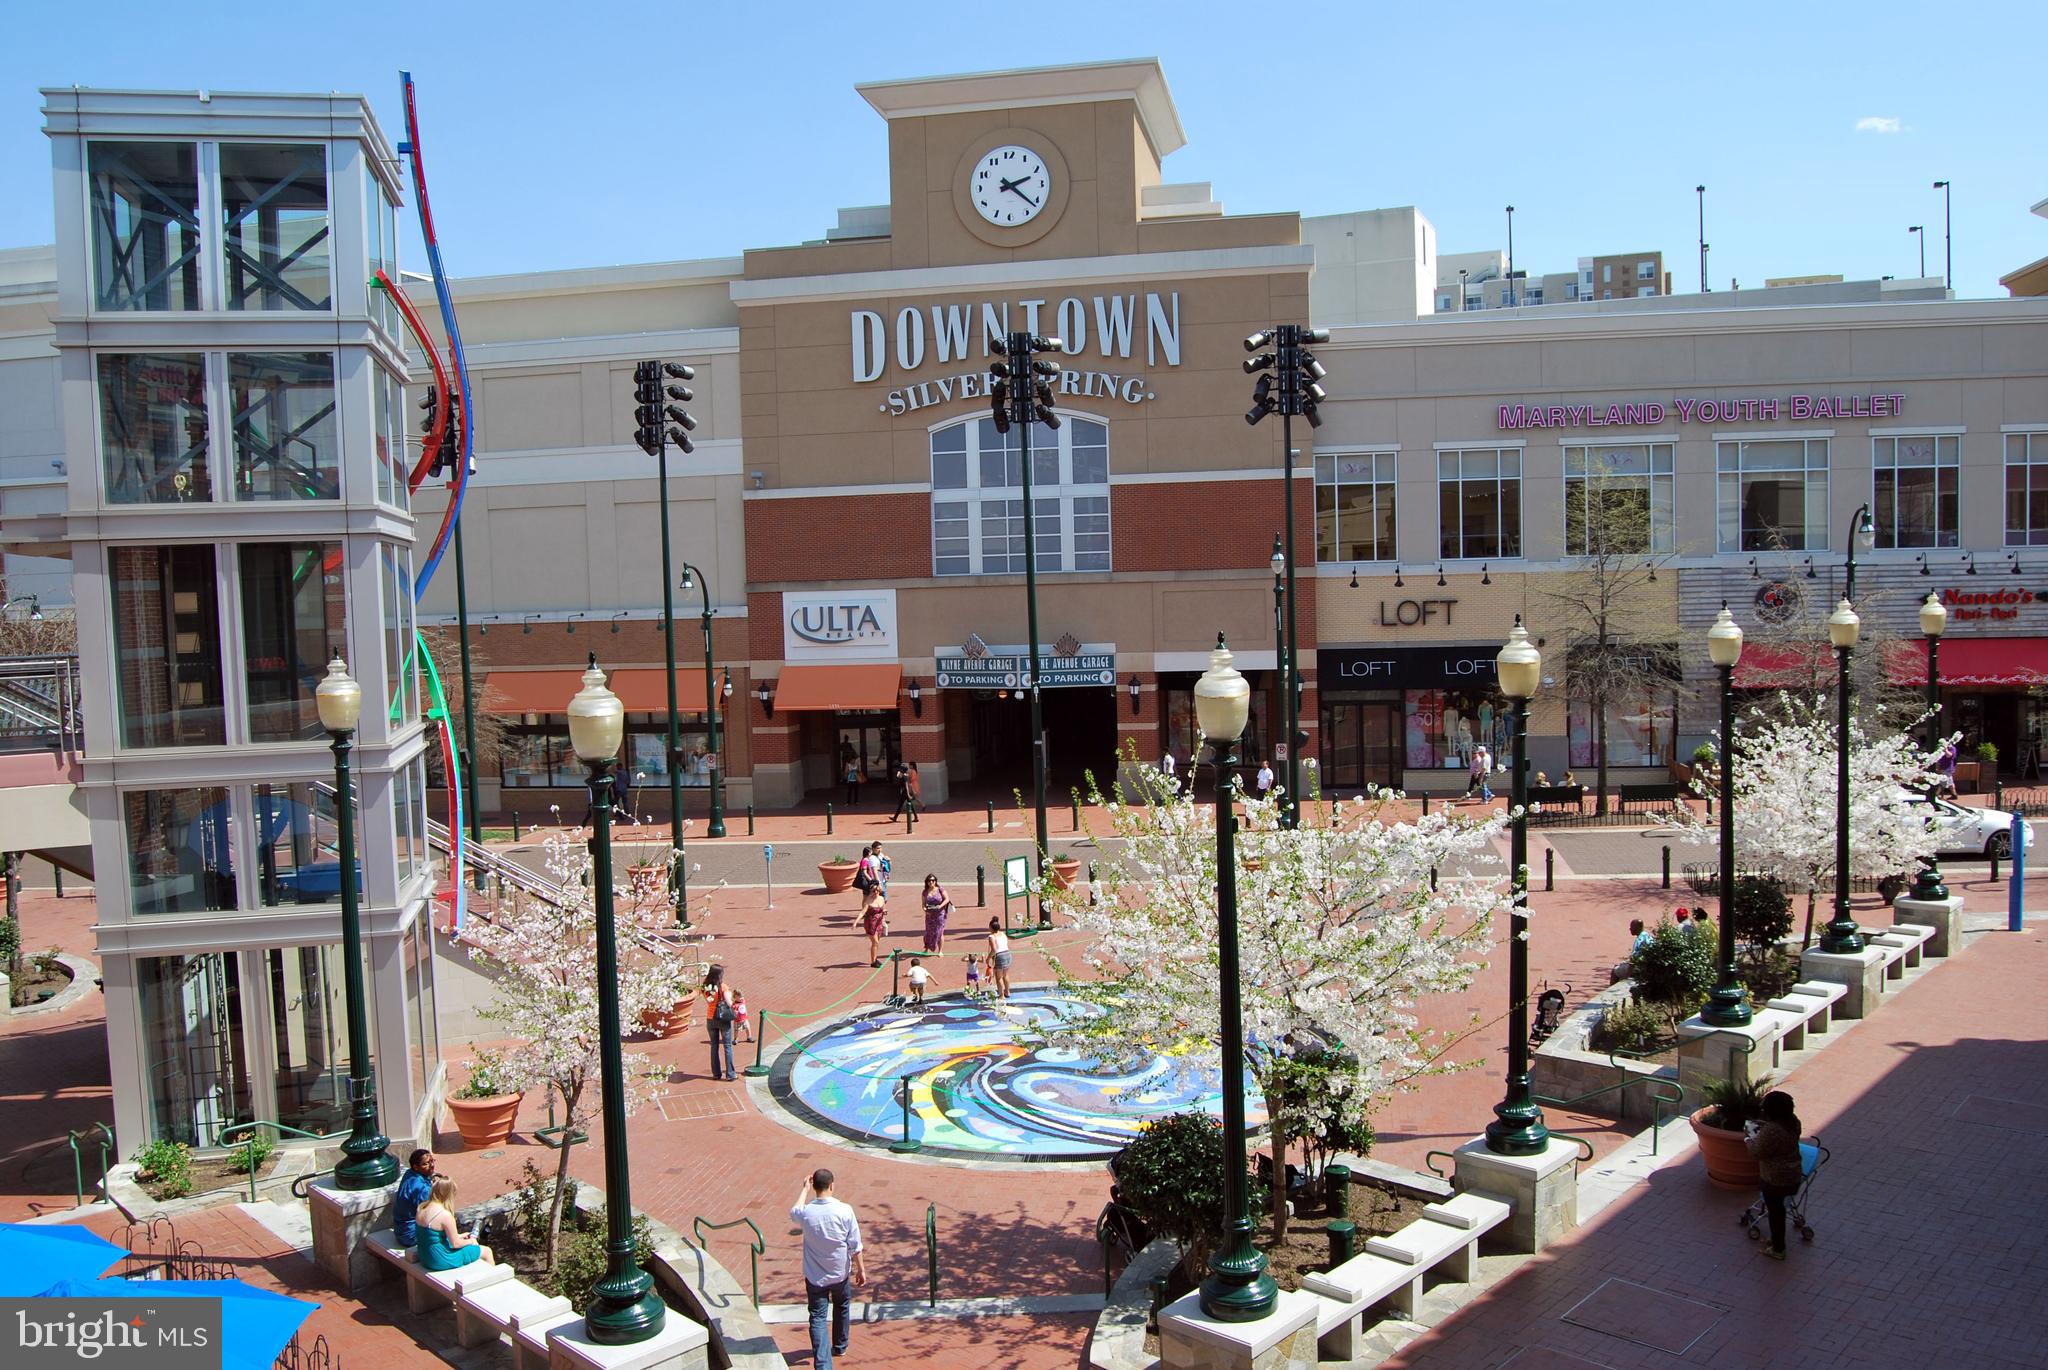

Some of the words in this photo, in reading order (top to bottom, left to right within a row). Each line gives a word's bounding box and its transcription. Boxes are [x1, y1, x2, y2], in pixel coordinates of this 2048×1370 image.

[851, 291, 1181, 383] DOWNTOWN
[1498, 402, 1665, 429] MARYLAND
[1675, 398, 1779, 423] YOUTH
[1790, 394, 1906, 418] BALLET
[1942, 587, 2033, 606] Nando's
[802, 605, 881, 632] ULTA
[1380, 600, 1458, 627] LOFT
[941, 659, 960, 671] WAYNE
[964, 659, 986, 671] AVENUE
[989, 659, 1012, 671] GARAGE
[1025, 658, 1049, 671] WNE
[1052, 657, 1078, 670] AVENUE
[1082, 656, 1109, 669] GARAGE
[1340, 660, 1397, 677] LOFT
[1444, 659, 1498, 675] LOFT
[1607, 656, 1652, 671] OFT
[951, 676, 963, 684] TO
[965, 676, 1004, 684] PARKING
[1054, 674, 1099, 683] PARKING
